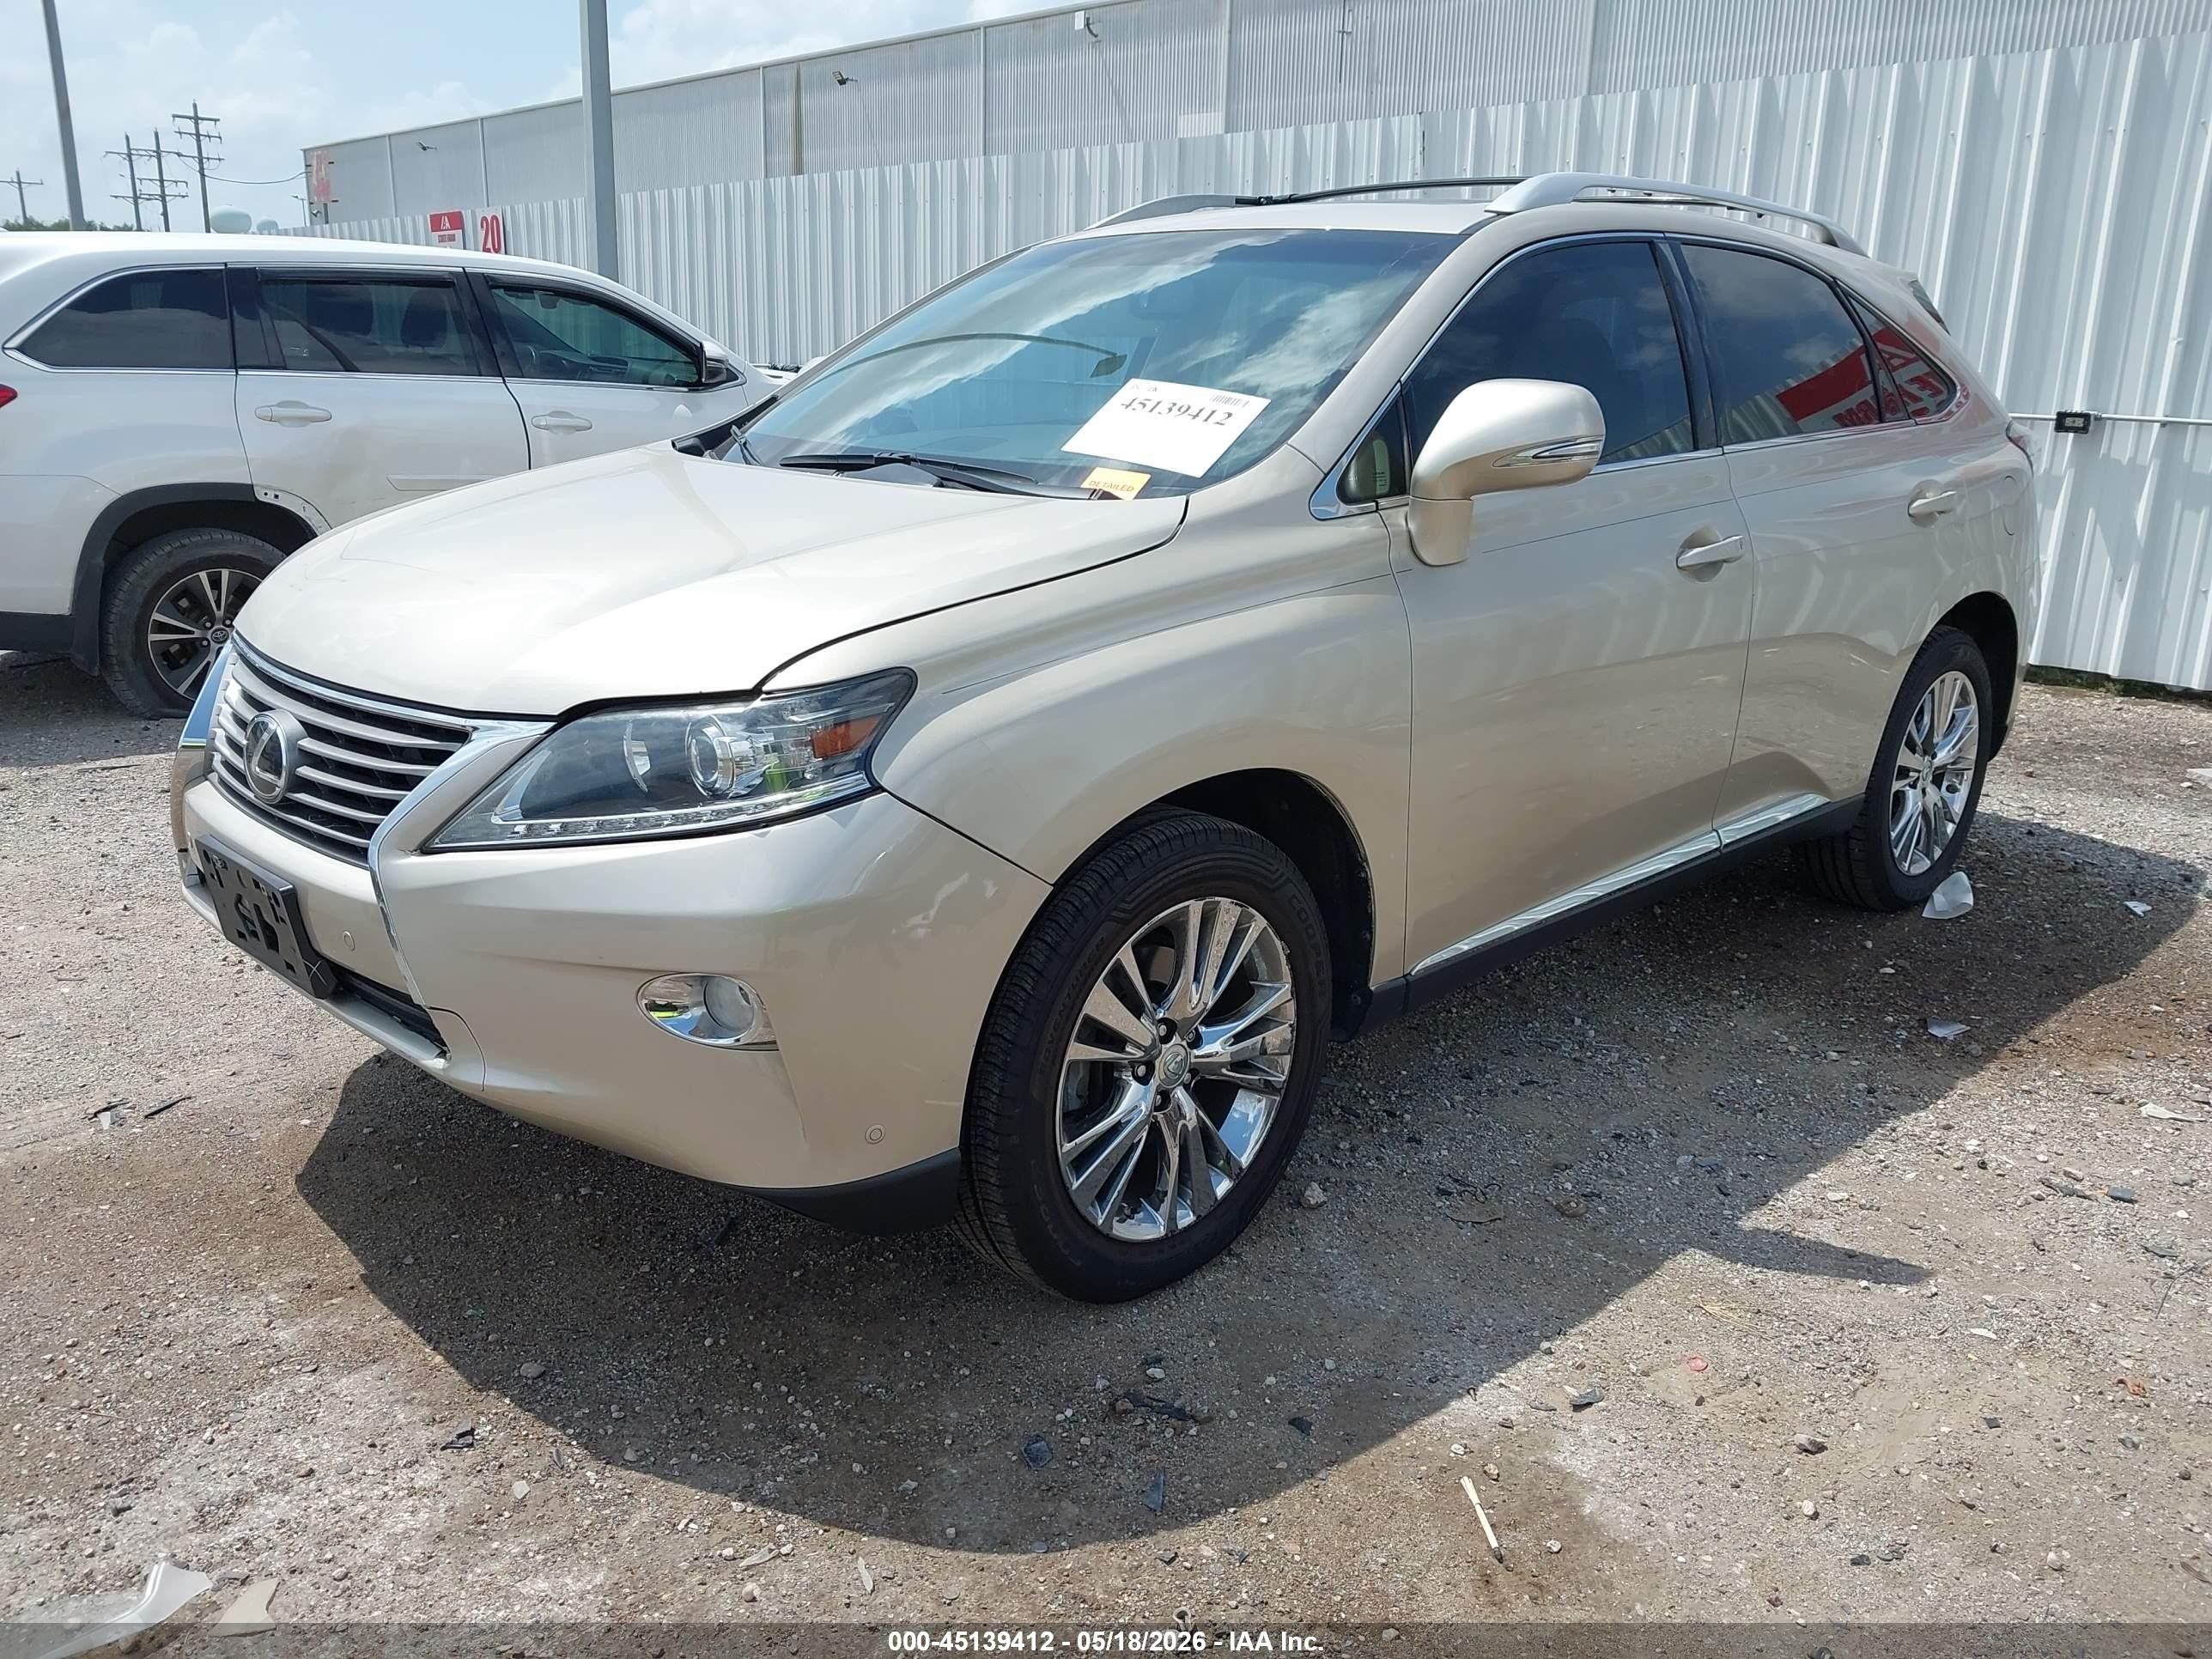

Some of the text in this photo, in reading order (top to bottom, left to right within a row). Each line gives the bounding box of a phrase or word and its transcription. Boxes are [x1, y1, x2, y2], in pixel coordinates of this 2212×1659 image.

[480, 215, 501, 253] 20
[1121, 398, 1233, 426] 45139412
[1088, 481, 1135, 493] DETAILED
